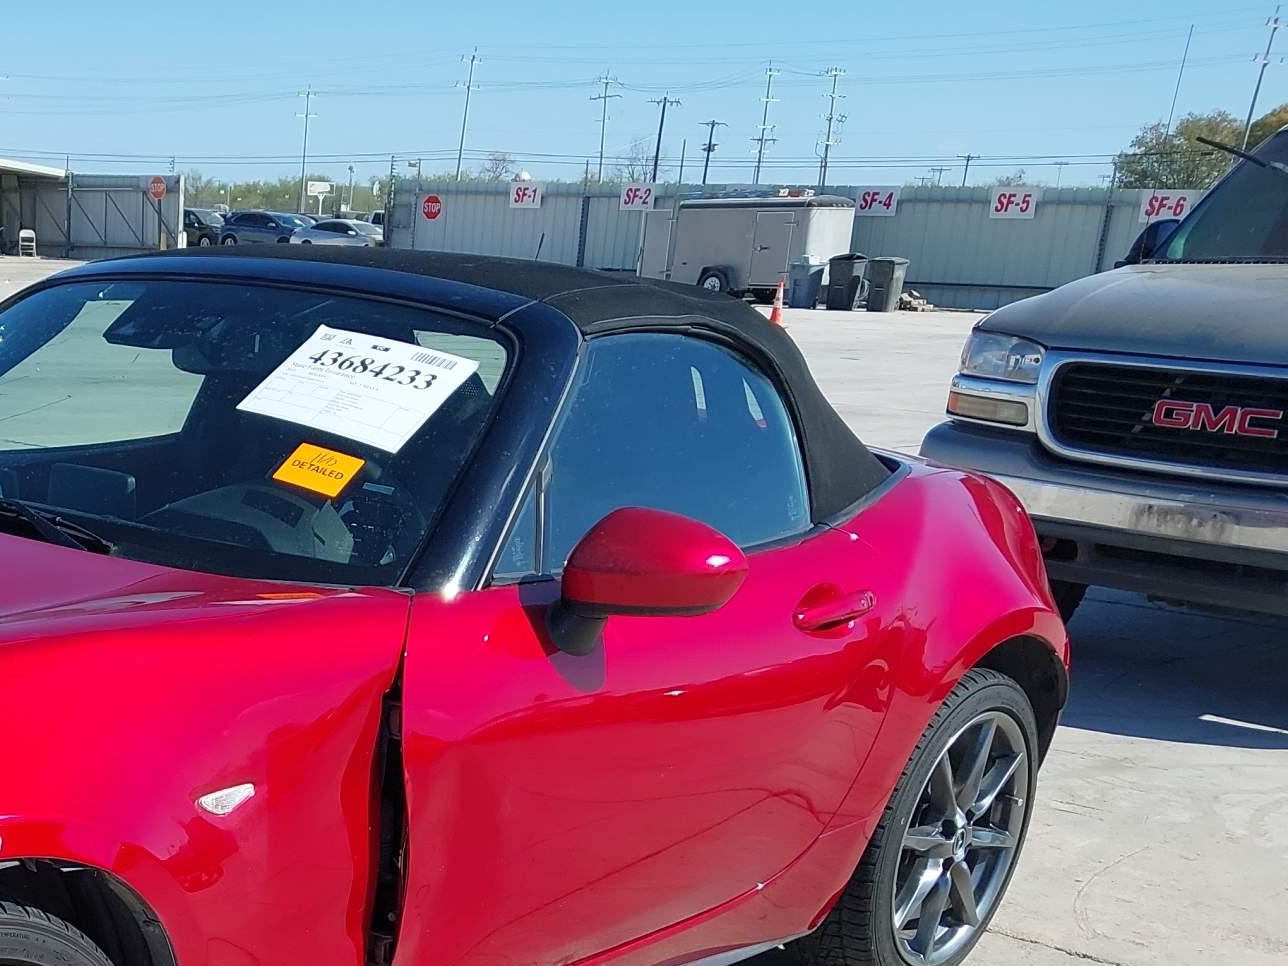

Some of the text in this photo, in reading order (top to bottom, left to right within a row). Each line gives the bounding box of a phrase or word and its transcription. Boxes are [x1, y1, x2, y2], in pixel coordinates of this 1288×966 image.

[514, 186, 538, 204] SF-1
[623, 187, 652, 206] SF-2
[859, 191, 894, 211] SF-4
[994, 192, 1032, 213] SF-5
[423, 202, 441, 213] STOP
[1144, 195, 1187, 218] SF-6
[308, 349, 438, 391] 43684233
[1152, 399, 1283, 438] GMC
[291, 459, 345, 480] DETAILED
